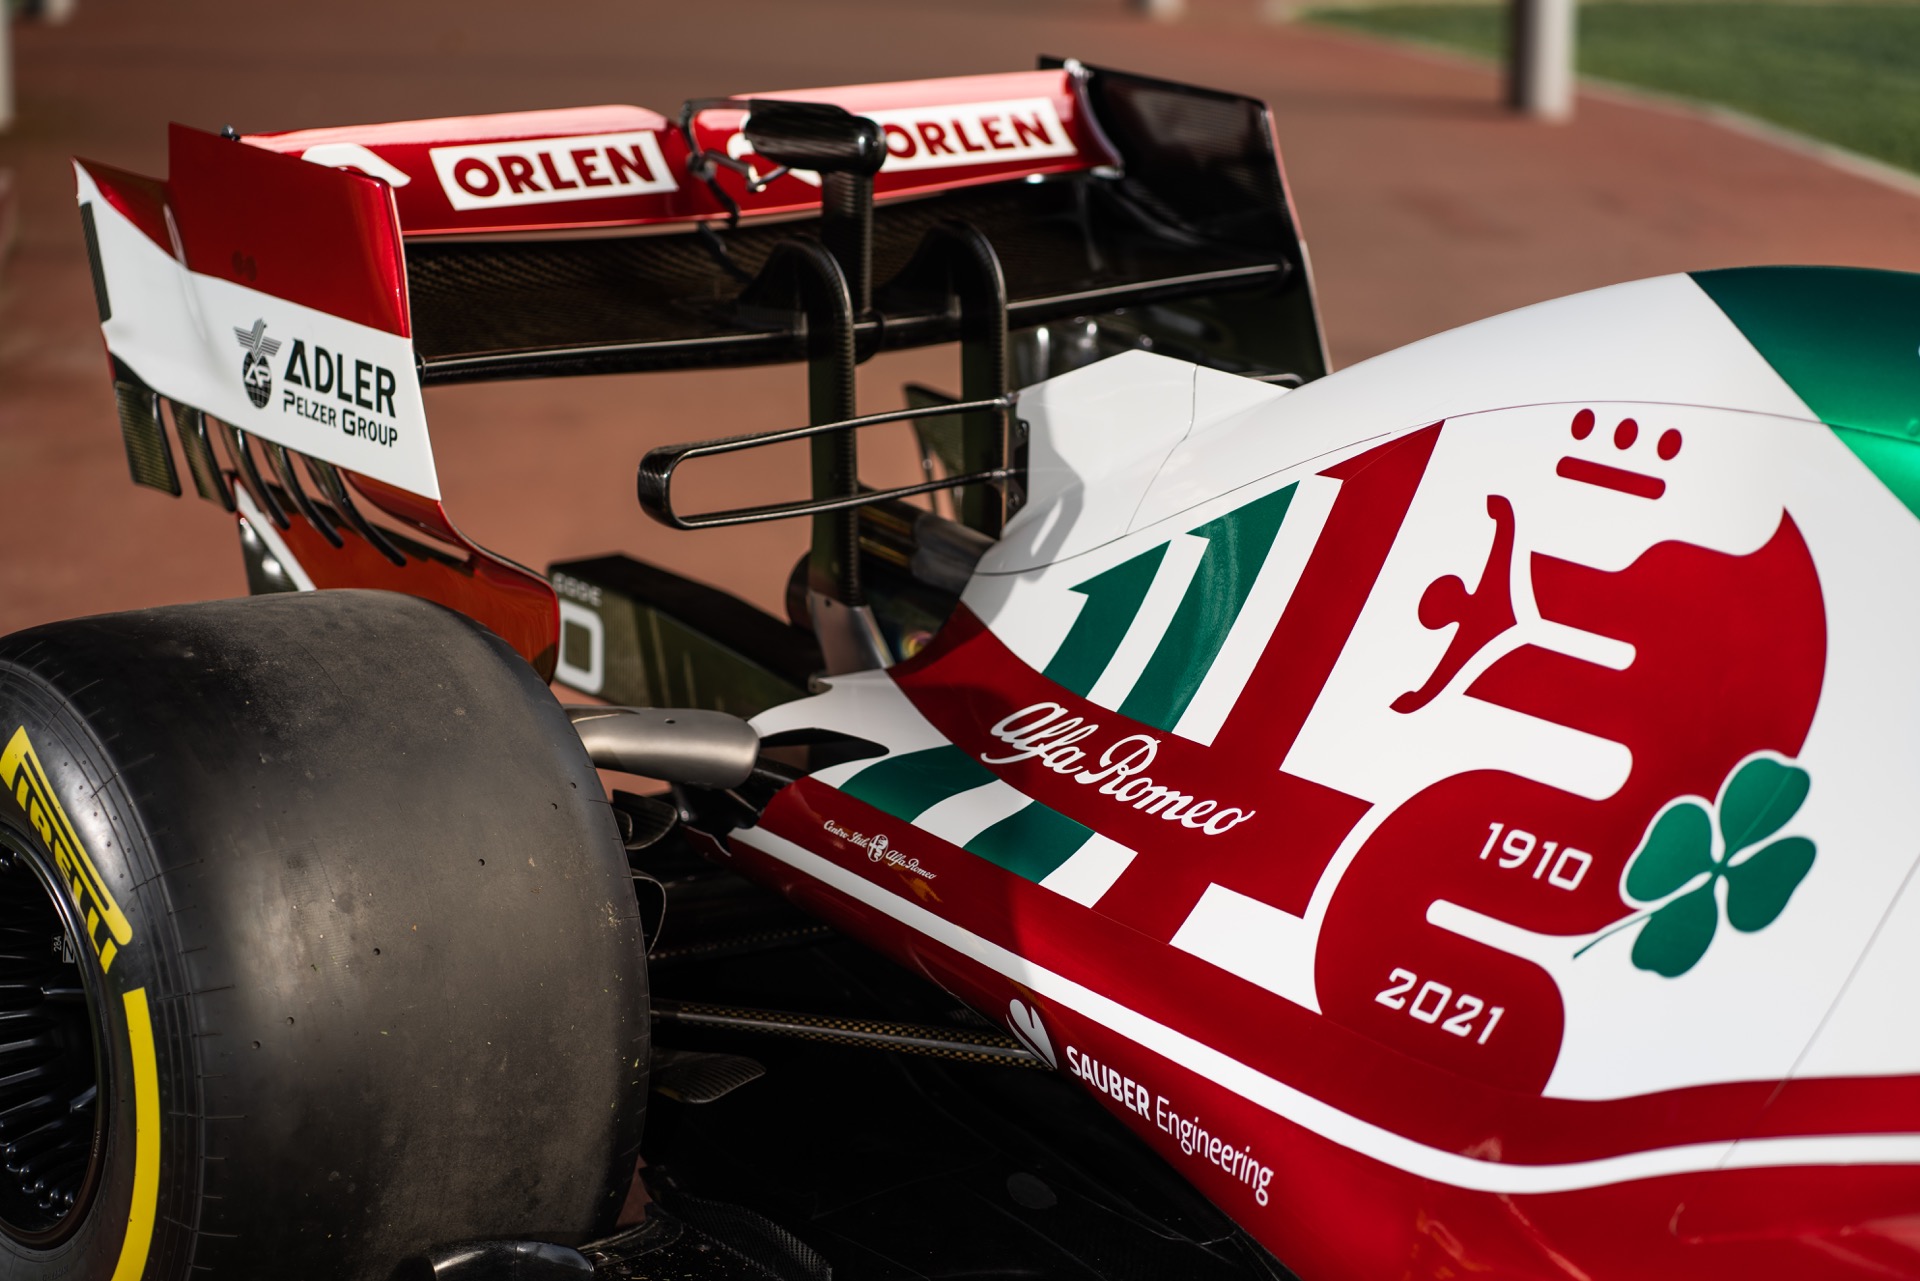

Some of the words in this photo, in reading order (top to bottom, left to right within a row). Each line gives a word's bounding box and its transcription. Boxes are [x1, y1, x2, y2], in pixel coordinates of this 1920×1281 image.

[453, 144, 656, 198] ORLEN
[882, 112, 1054, 159] ORLEN
[284, 338, 397, 418] ADLER
[283, 390, 336, 428] PELZER
[342, 408, 398, 448] GROUP
[980, 702, 1083, 774] Alfa
[1074, 734, 1256, 836] Romeo
[0, 725, 133, 974] PIRELLI
[823, 819, 850, 839] Centro
[847, 831, 871, 848] Stile
[885, 850, 907, 867] Alfa
[904, 858, 937, 879] Romeo
[1479, 822, 1593, 891] 1910
[1374, 967, 1505, 1045] 2021
[1066, 1045, 1151, 1121] SAUBER
[1156, 1095, 1274, 1206] Engineering
